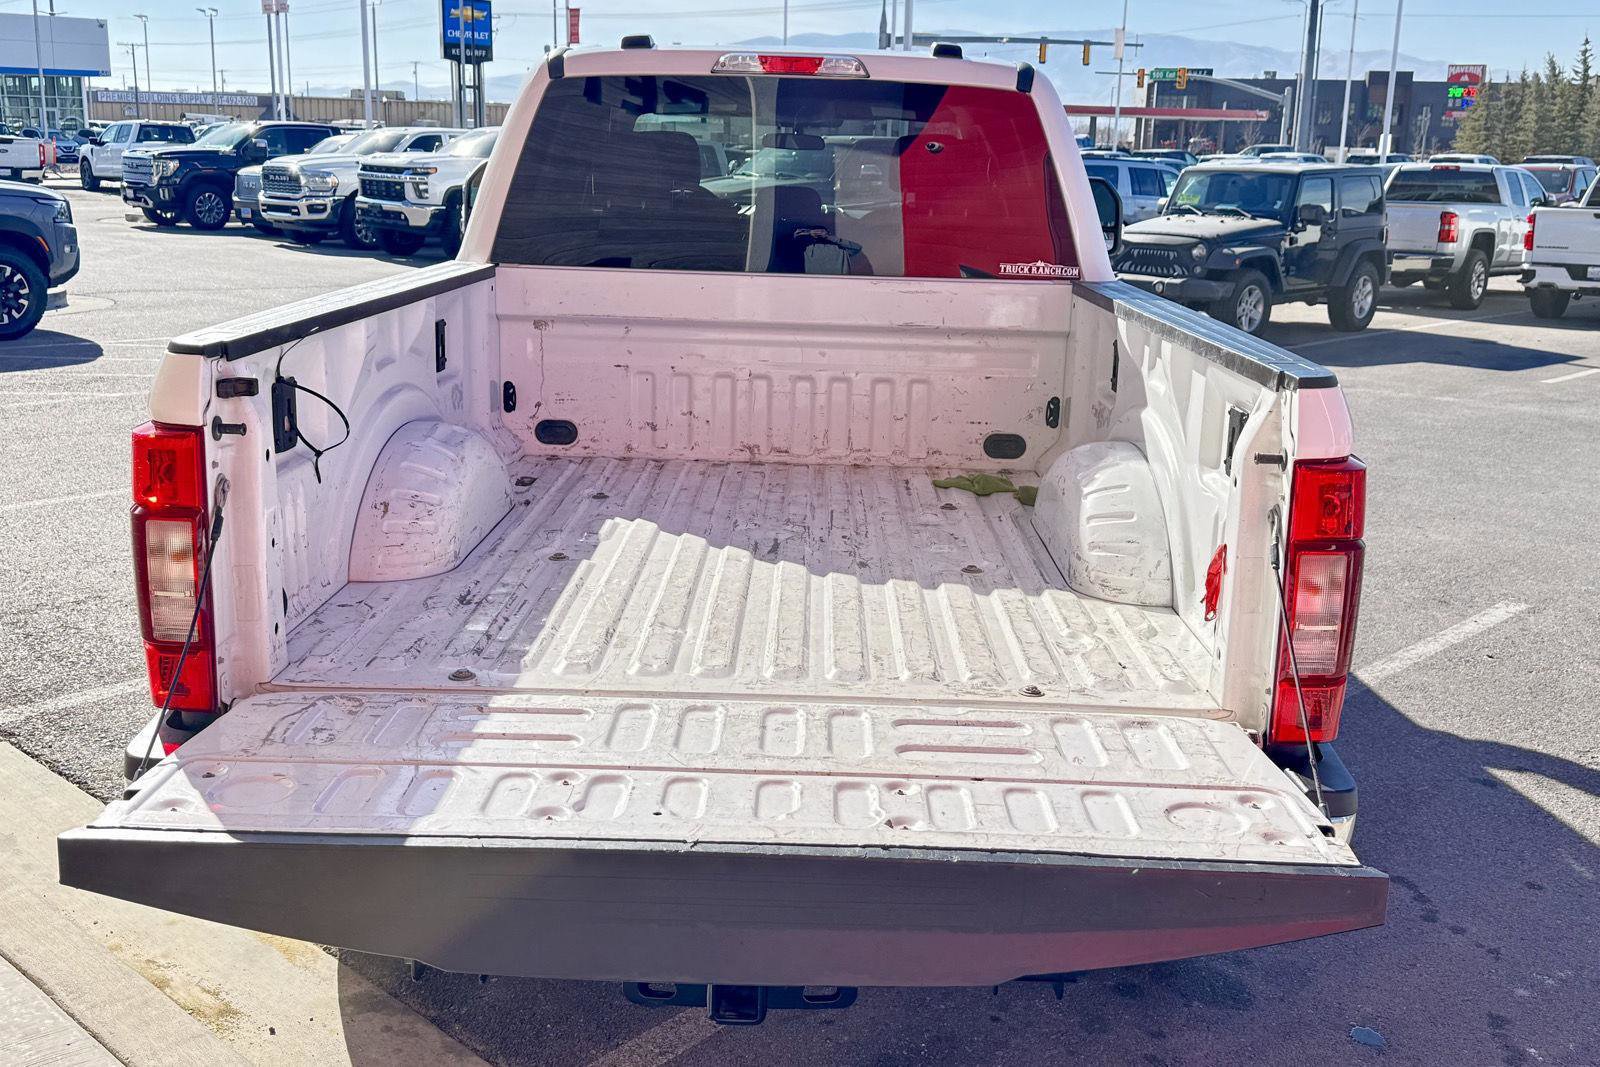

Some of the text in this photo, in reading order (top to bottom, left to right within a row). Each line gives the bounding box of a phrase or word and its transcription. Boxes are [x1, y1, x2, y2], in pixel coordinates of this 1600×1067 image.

[451, 48, 463, 56] KE
[1448, 65, 1483, 77] MAVERIK
[100, 92, 136, 102] PREMIER
[139, 93, 177, 103] BUILDING
[178, 94, 208, 104] SUPPLY
[1000, 264, 1030, 274] TRUCK
